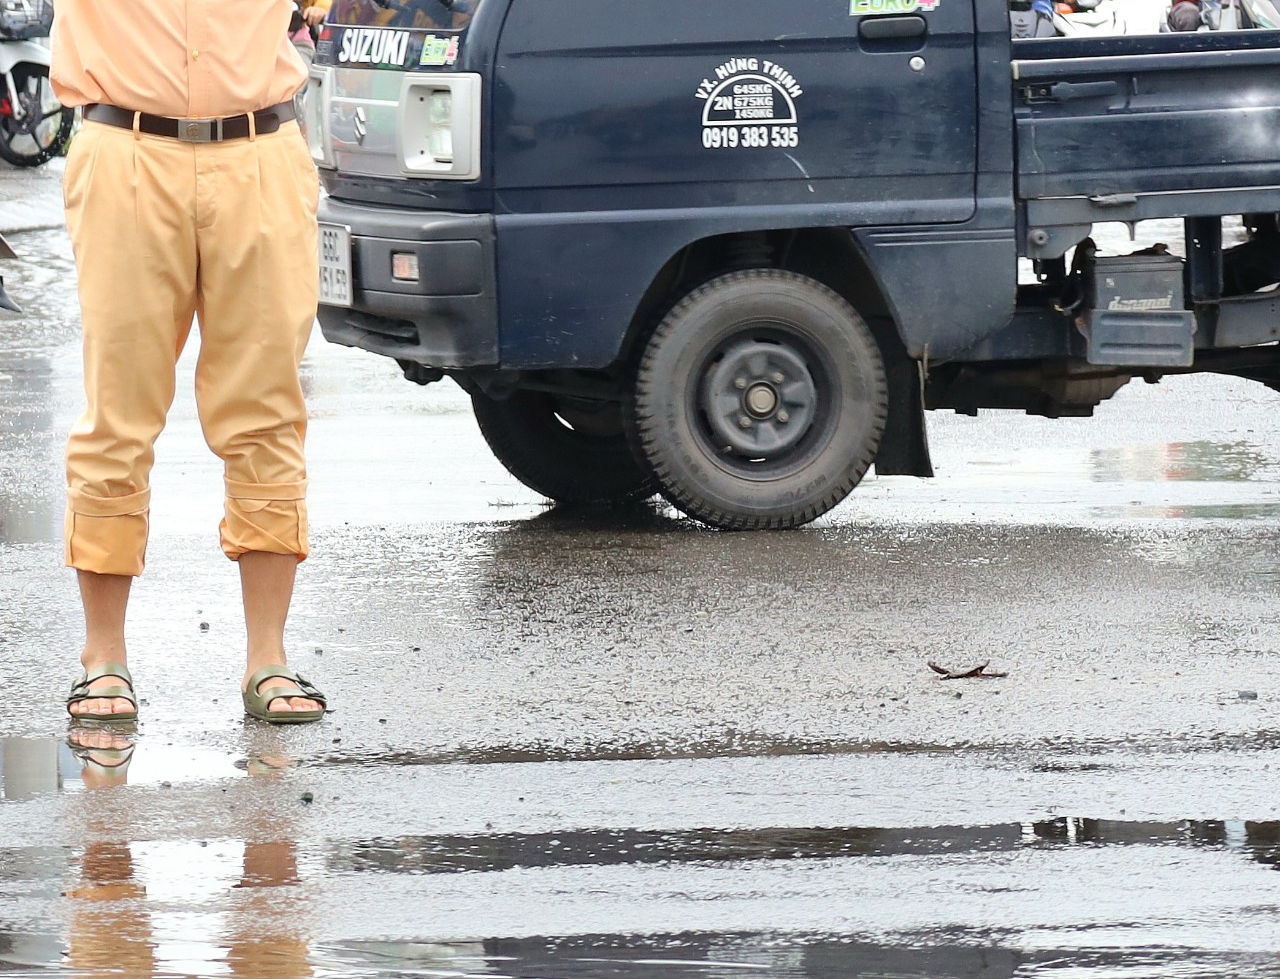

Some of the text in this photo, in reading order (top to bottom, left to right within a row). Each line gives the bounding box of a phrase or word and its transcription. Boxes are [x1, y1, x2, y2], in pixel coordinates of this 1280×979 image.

[338, 28, 410, 66] SUZUKI
[733, 84, 772, 94] 645KG
[763, 60, 803, 98] THỊNH
[713, 96, 773, 110] 2N 675KG
[702, 126, 799, 148] 0919 383 535
